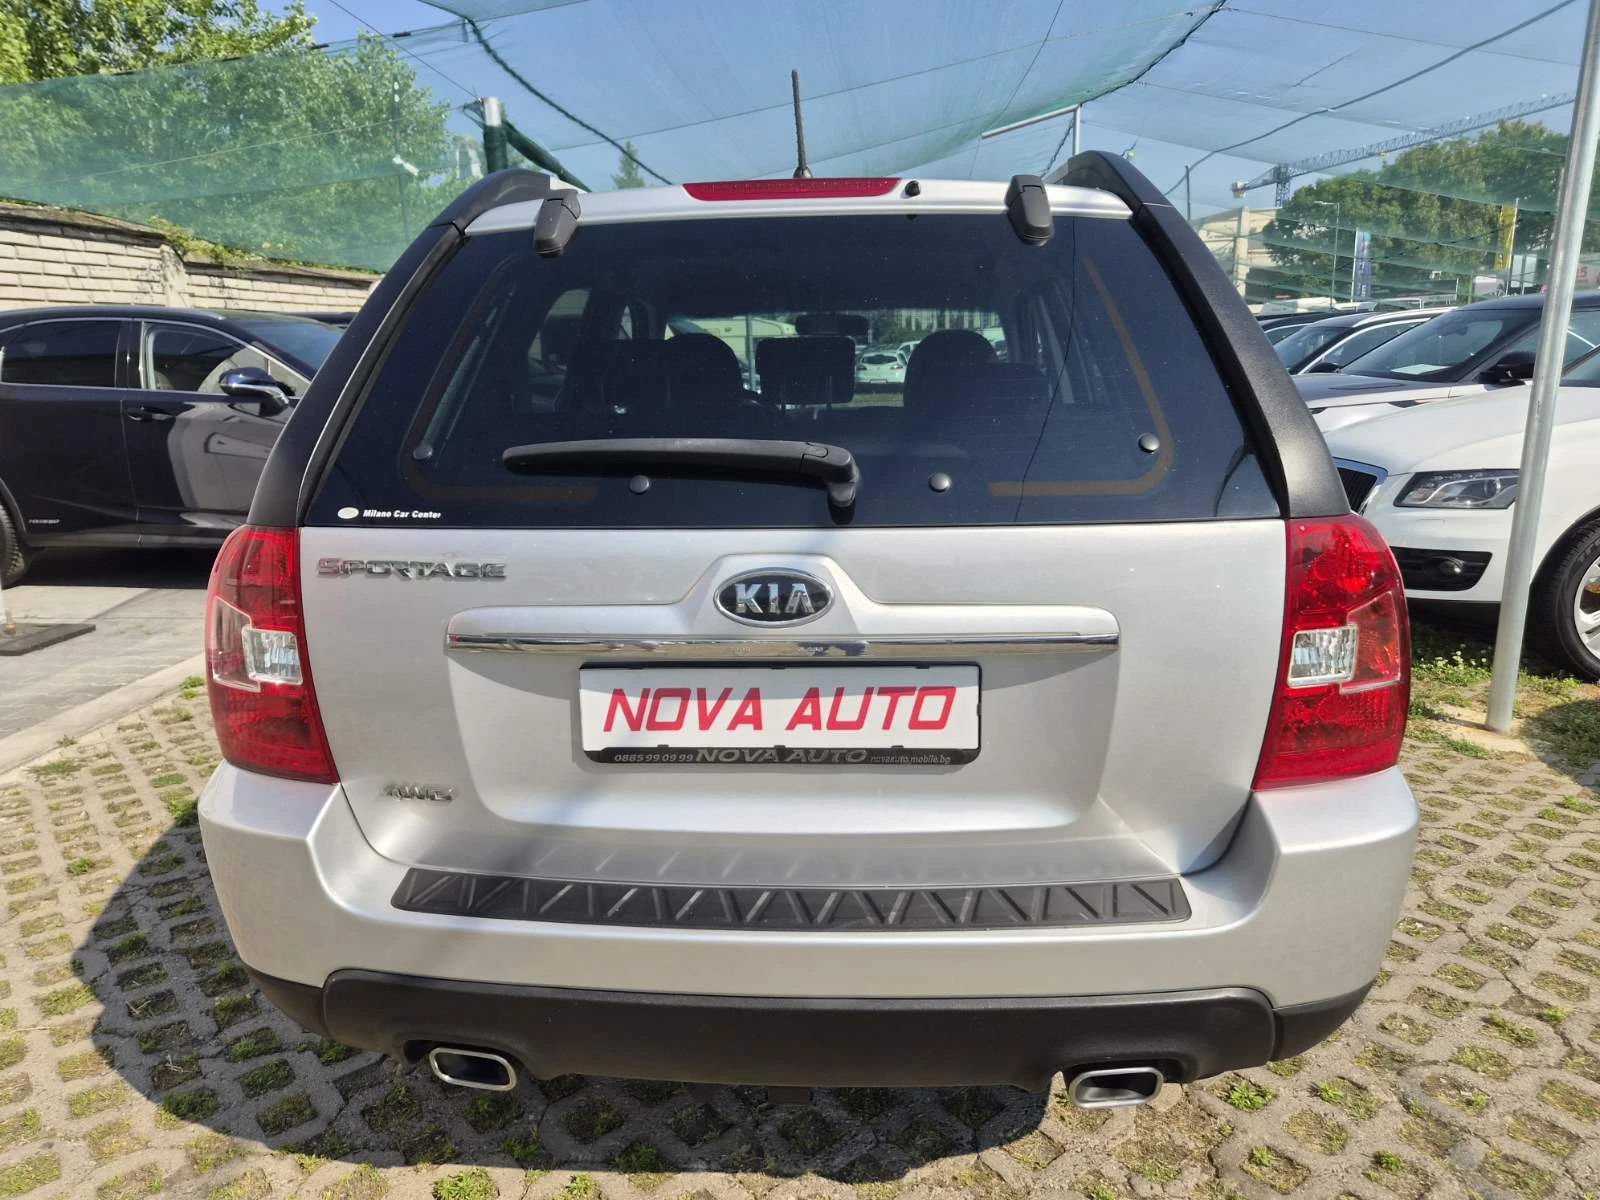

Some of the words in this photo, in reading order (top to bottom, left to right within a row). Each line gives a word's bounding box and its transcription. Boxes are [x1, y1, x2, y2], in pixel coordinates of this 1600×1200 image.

[362, 509, 392, 518] Milano
[393, 509, 410, 518] Car
[411, 510, 442, 519] Center
[317, 557, 506, 579] SPORTAGE
[734, 583, 815, 614] KIA
[603, 687, 763, 732] NOVA
[784, 686, 956, 732] AUTO
[695, 748, 780, 763] NOVA
[783, 748, 867, 763] AUTO
